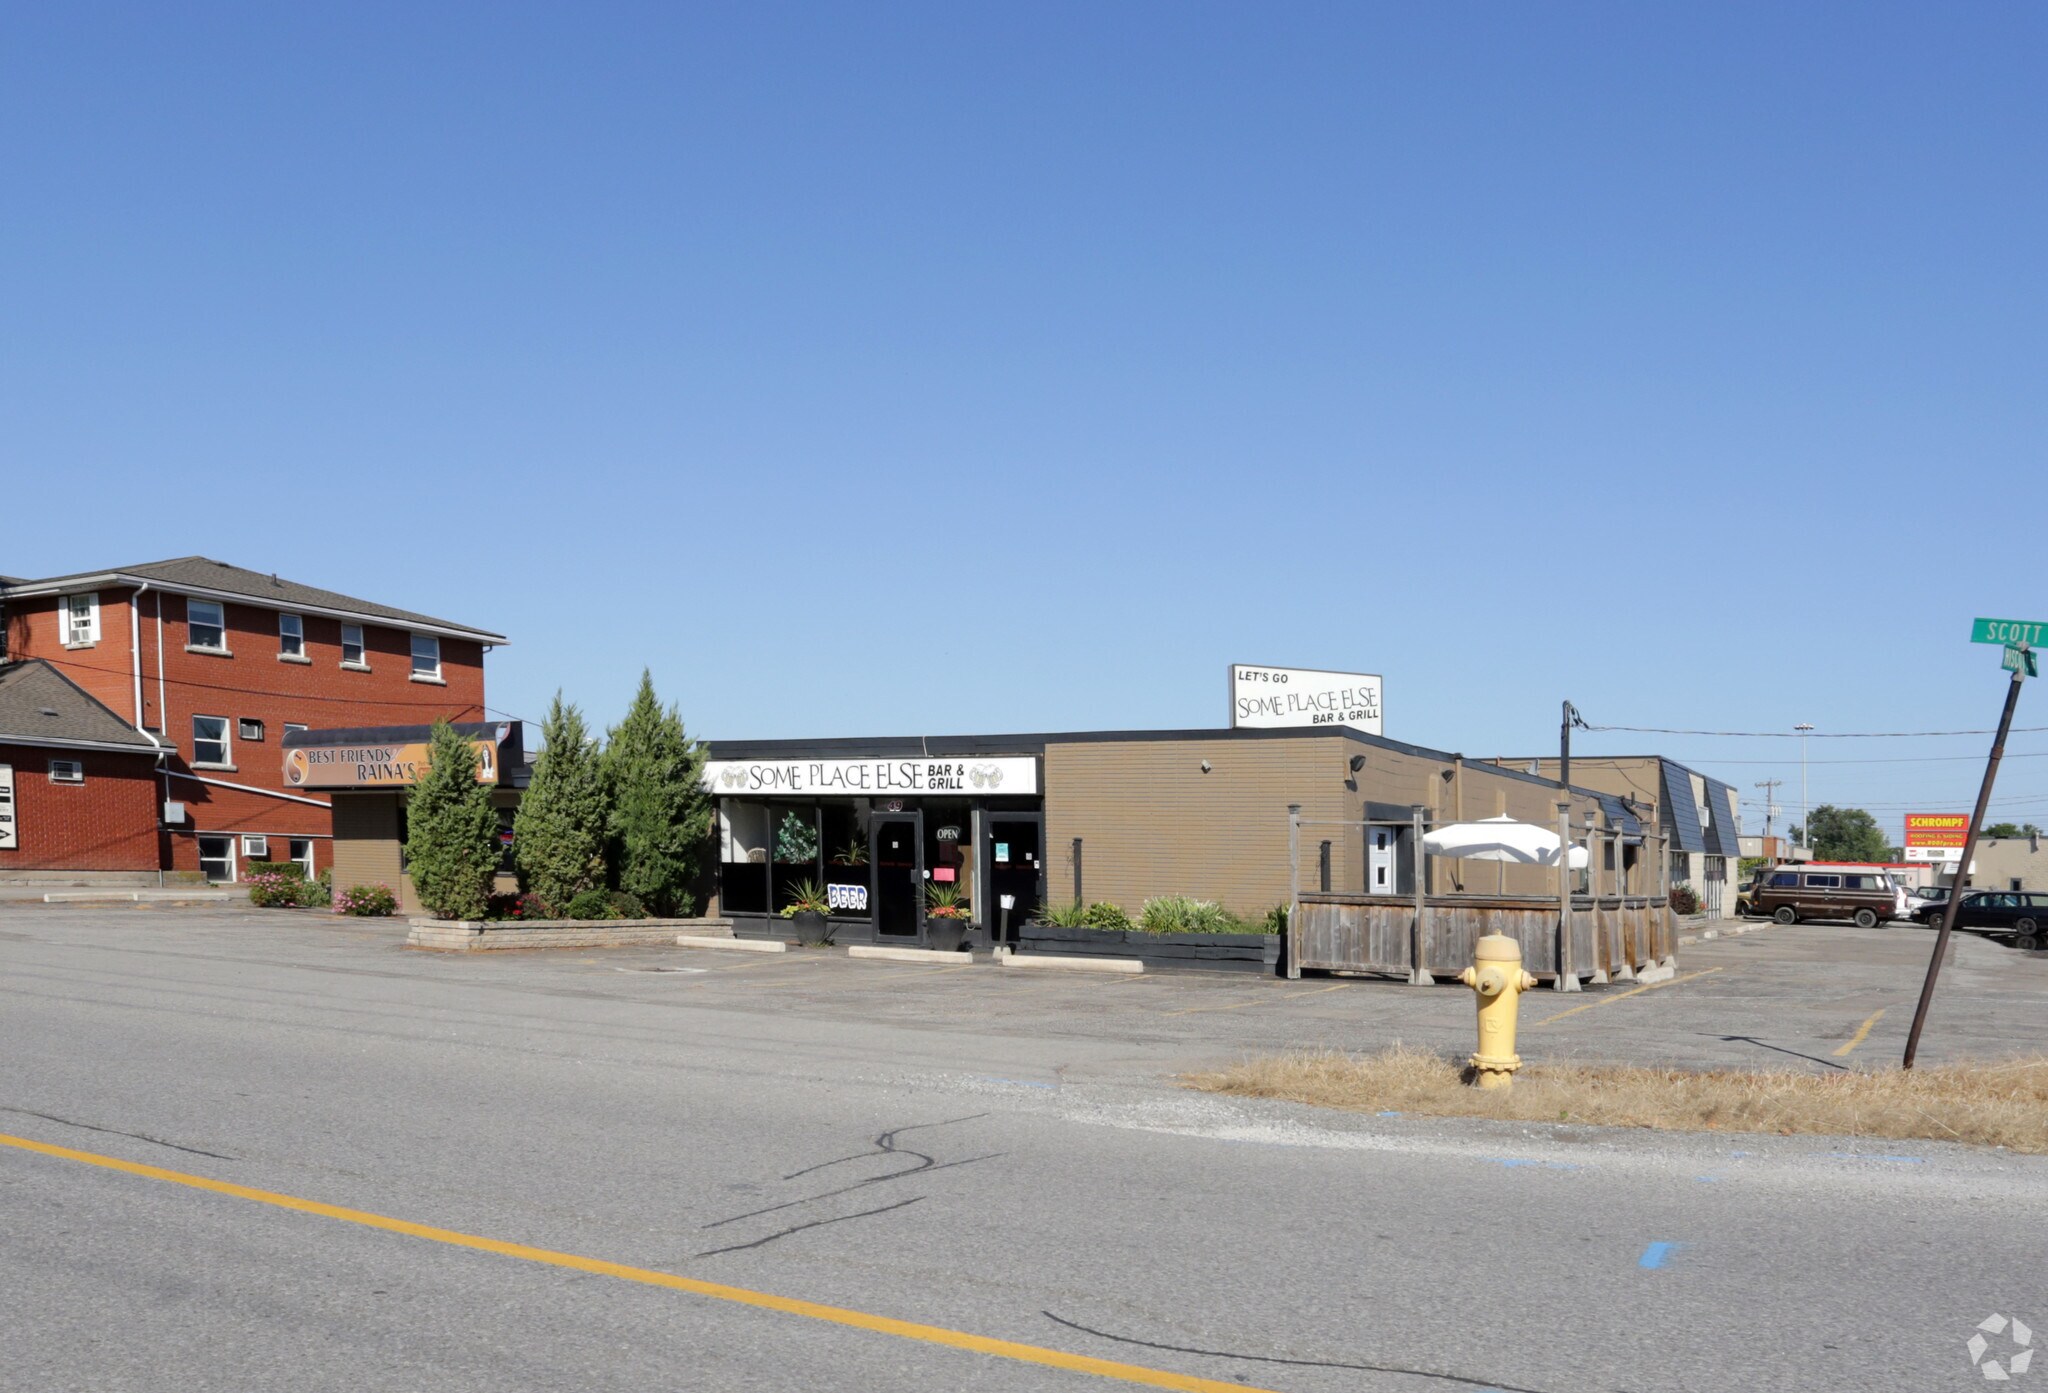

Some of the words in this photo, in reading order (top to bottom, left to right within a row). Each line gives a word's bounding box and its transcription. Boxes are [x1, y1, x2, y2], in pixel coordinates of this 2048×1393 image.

[1987, 622, 2042, 643] SCOTT
[1238, 671, 1269, 682] LET'S
[1272, 673, 1288, 684] GO
[1238, 696, 1284, 719] SOME
[1287, 691, 1338, 712] PLACE
[1341, 687, 1378, 710] ELSE
[1312, 712, 1334, 724] BAR
[1338, 712, 1345, 722] &
[1348, 709, 1379, 721] GRILL
[309, 751, 336, 763] BEST
[340, 748, 391, 763] FRIENDS
[357, 763, 415, 780] RAINA'S
[750, 765, 802, 790] SOME
[809, 764, 870, 789] PLACE
[876, 763, 923, 789] ELSE
[927, 764, 951, 777] BAR
[956, 764, 965, 776] &
[928, 778, 964, 790] GRILL
[888, 801, 902, 811] 49
[1910, 818, 1964, 827] SCHROMPF
[937, 829, 958, 839] OPEN
[828, 884, 867, 909] BEER
